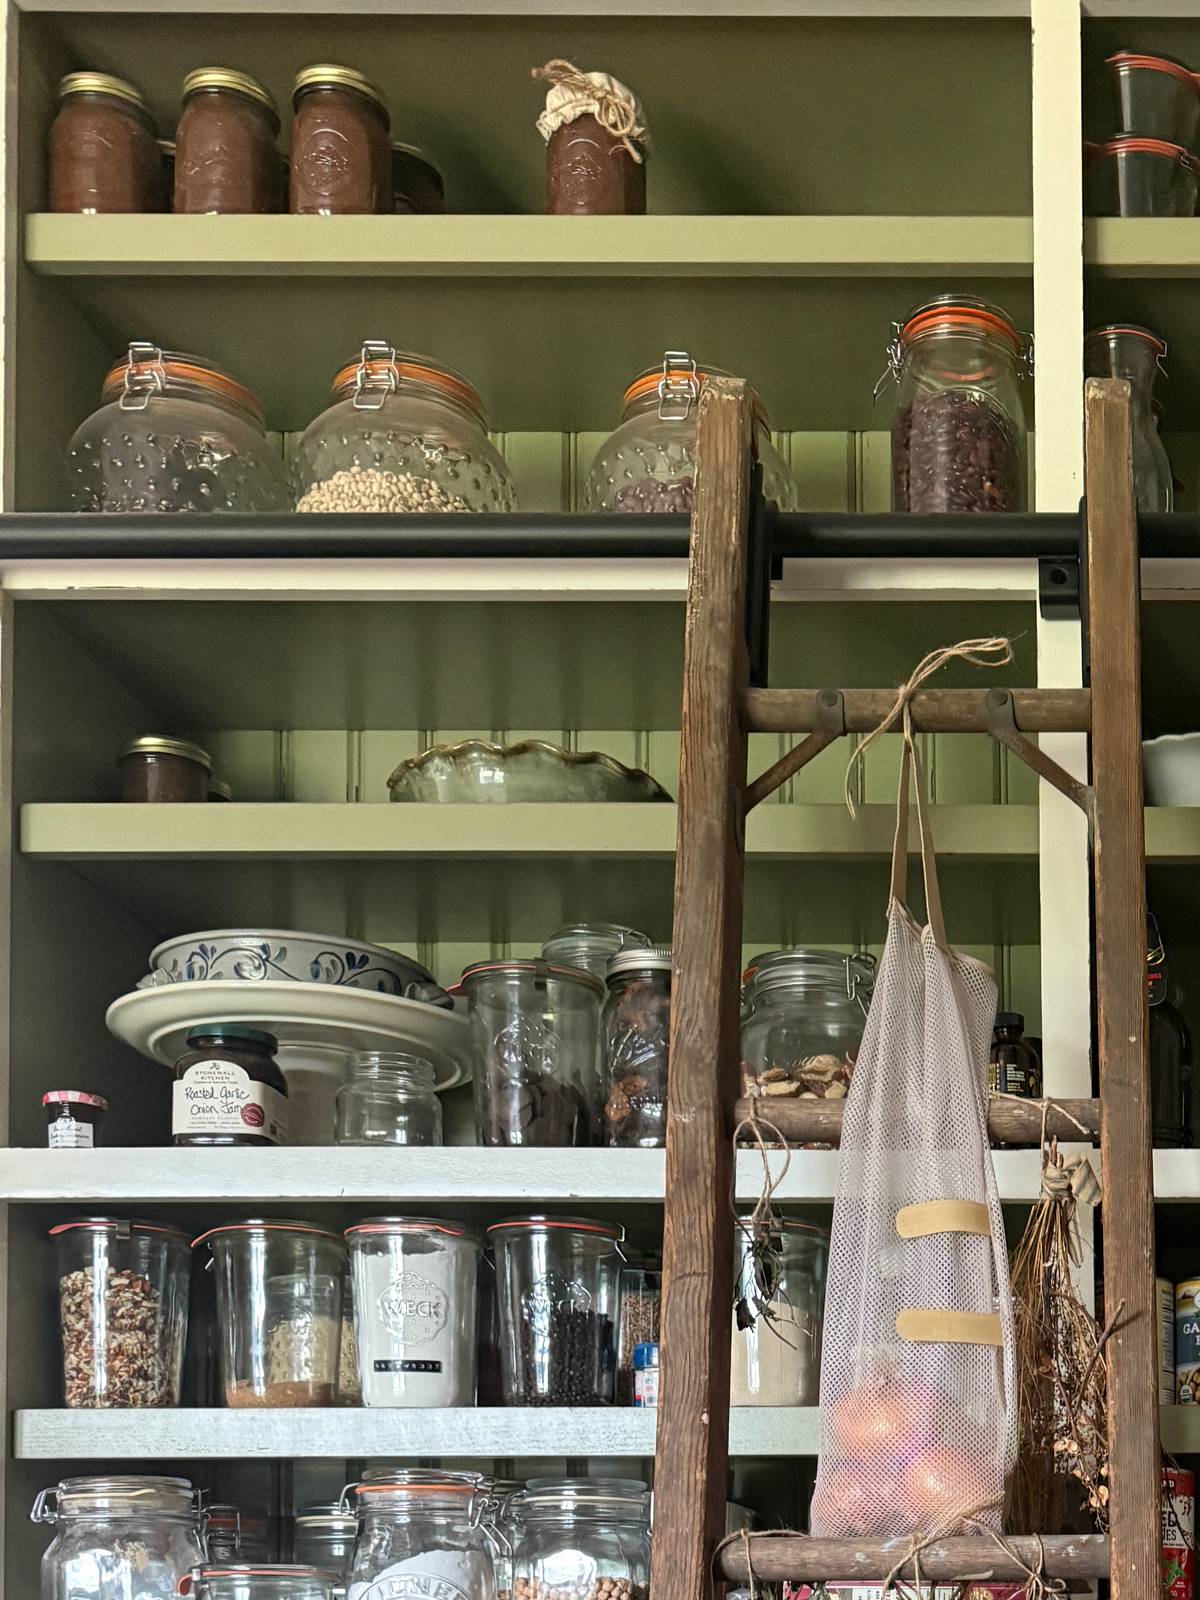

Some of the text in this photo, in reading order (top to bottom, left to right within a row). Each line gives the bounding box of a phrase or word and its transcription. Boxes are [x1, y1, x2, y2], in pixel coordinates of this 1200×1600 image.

[185, 1086, 250, 1101] Roasted Garlic
[191, 1101, 241, 1115] Onion Jam
